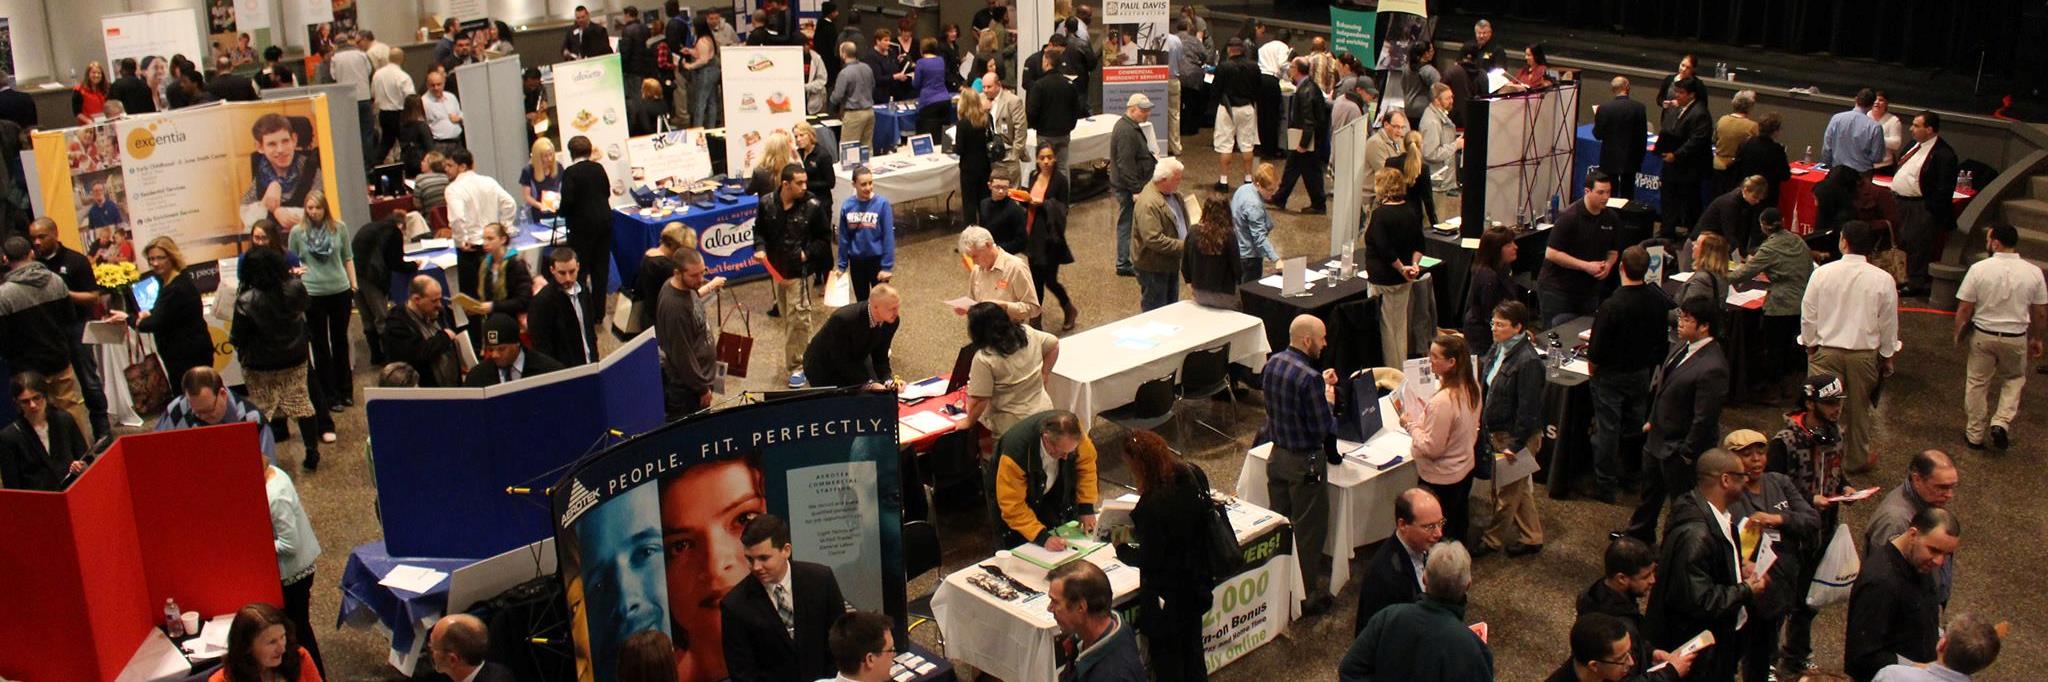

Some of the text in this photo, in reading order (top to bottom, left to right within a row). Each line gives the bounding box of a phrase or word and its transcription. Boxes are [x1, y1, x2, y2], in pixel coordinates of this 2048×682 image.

[1119, 1, 1167, 10] PAUL DAVIS
[134, 130, 187, 150] excentia
[704, 226, 755, 250] aloue
[608, 418, 888, 495] PEOPLE. FIT. PERFECTLY.
[808, 478, 857, 489] COMMERCIAL
[560, 487, 601, 527] AEROTEK
[1230, 601, 1268, 630] Bonus
[1225, 628, 1267, 661] online
[1231, 625, 1251, 641] Home
